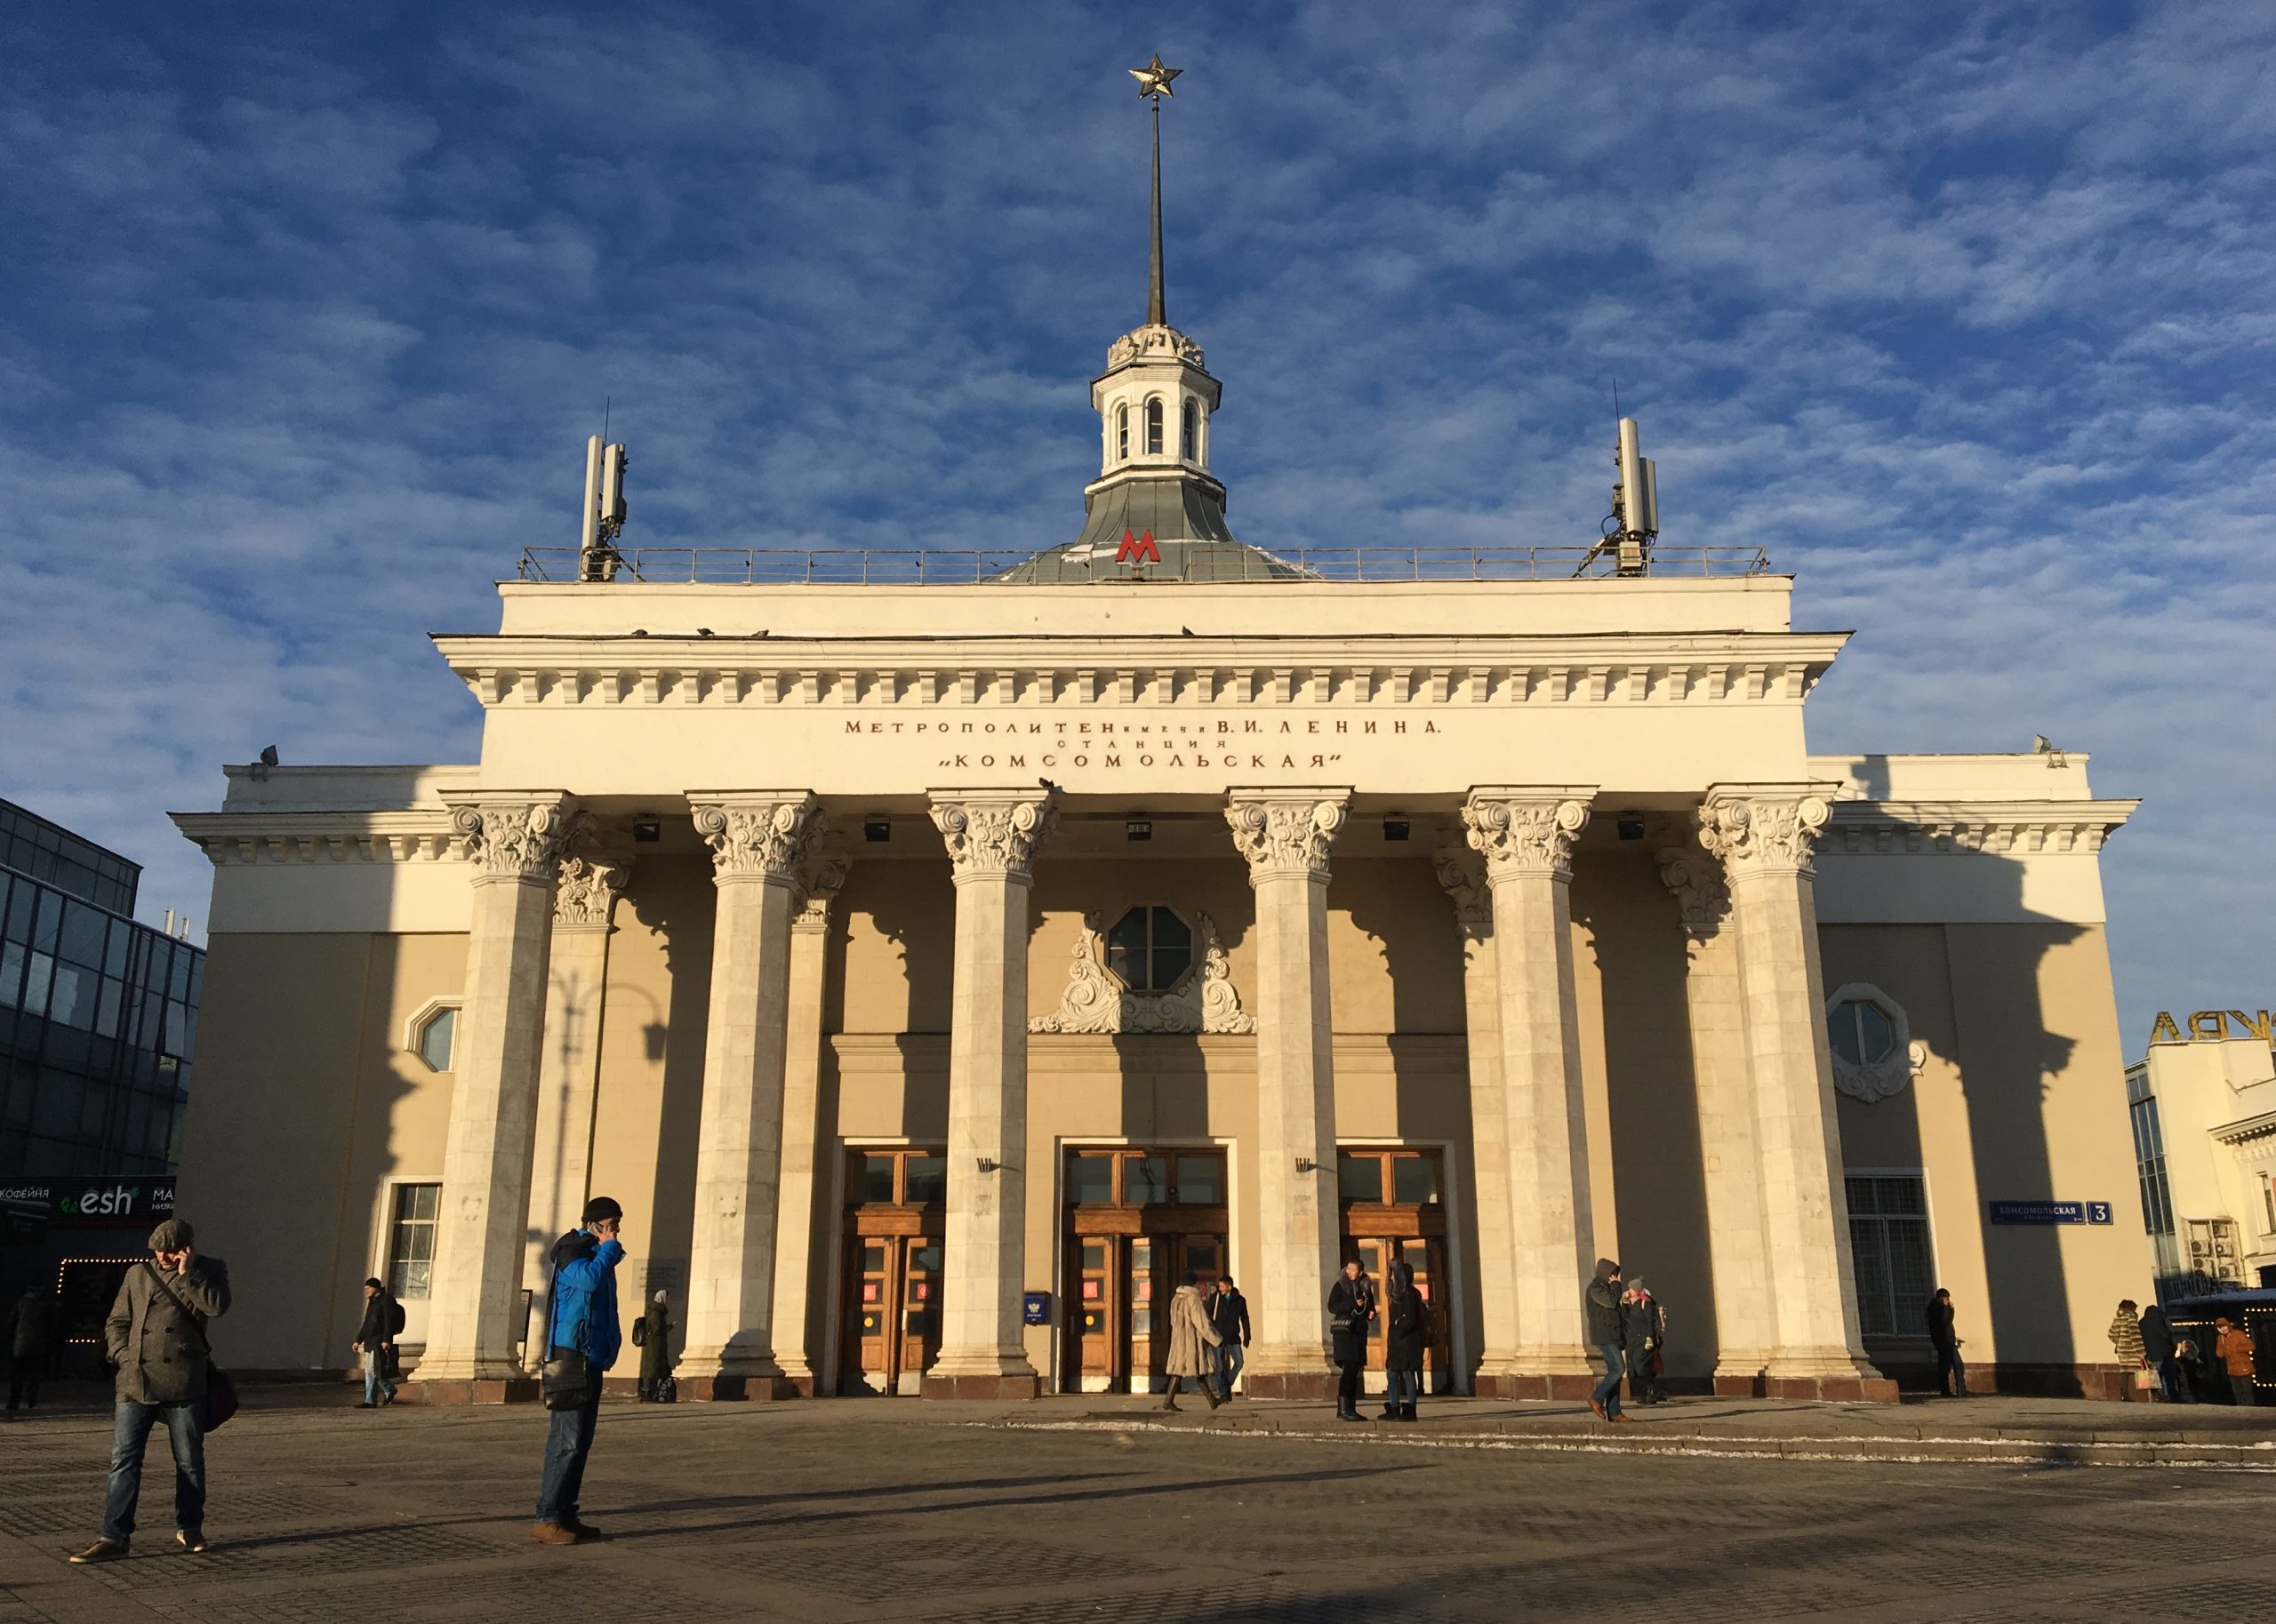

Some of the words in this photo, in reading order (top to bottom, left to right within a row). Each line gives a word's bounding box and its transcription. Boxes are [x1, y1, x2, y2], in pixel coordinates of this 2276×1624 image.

[1114, 528, 1161, 563] М
[1057, 740, 1226, 749] СТАНЦИЯ
[2000, 1206, 2077, 1215] КОМСОМОЛЬСКАЯ
[2095, 1204, 2106, 1221] 3
